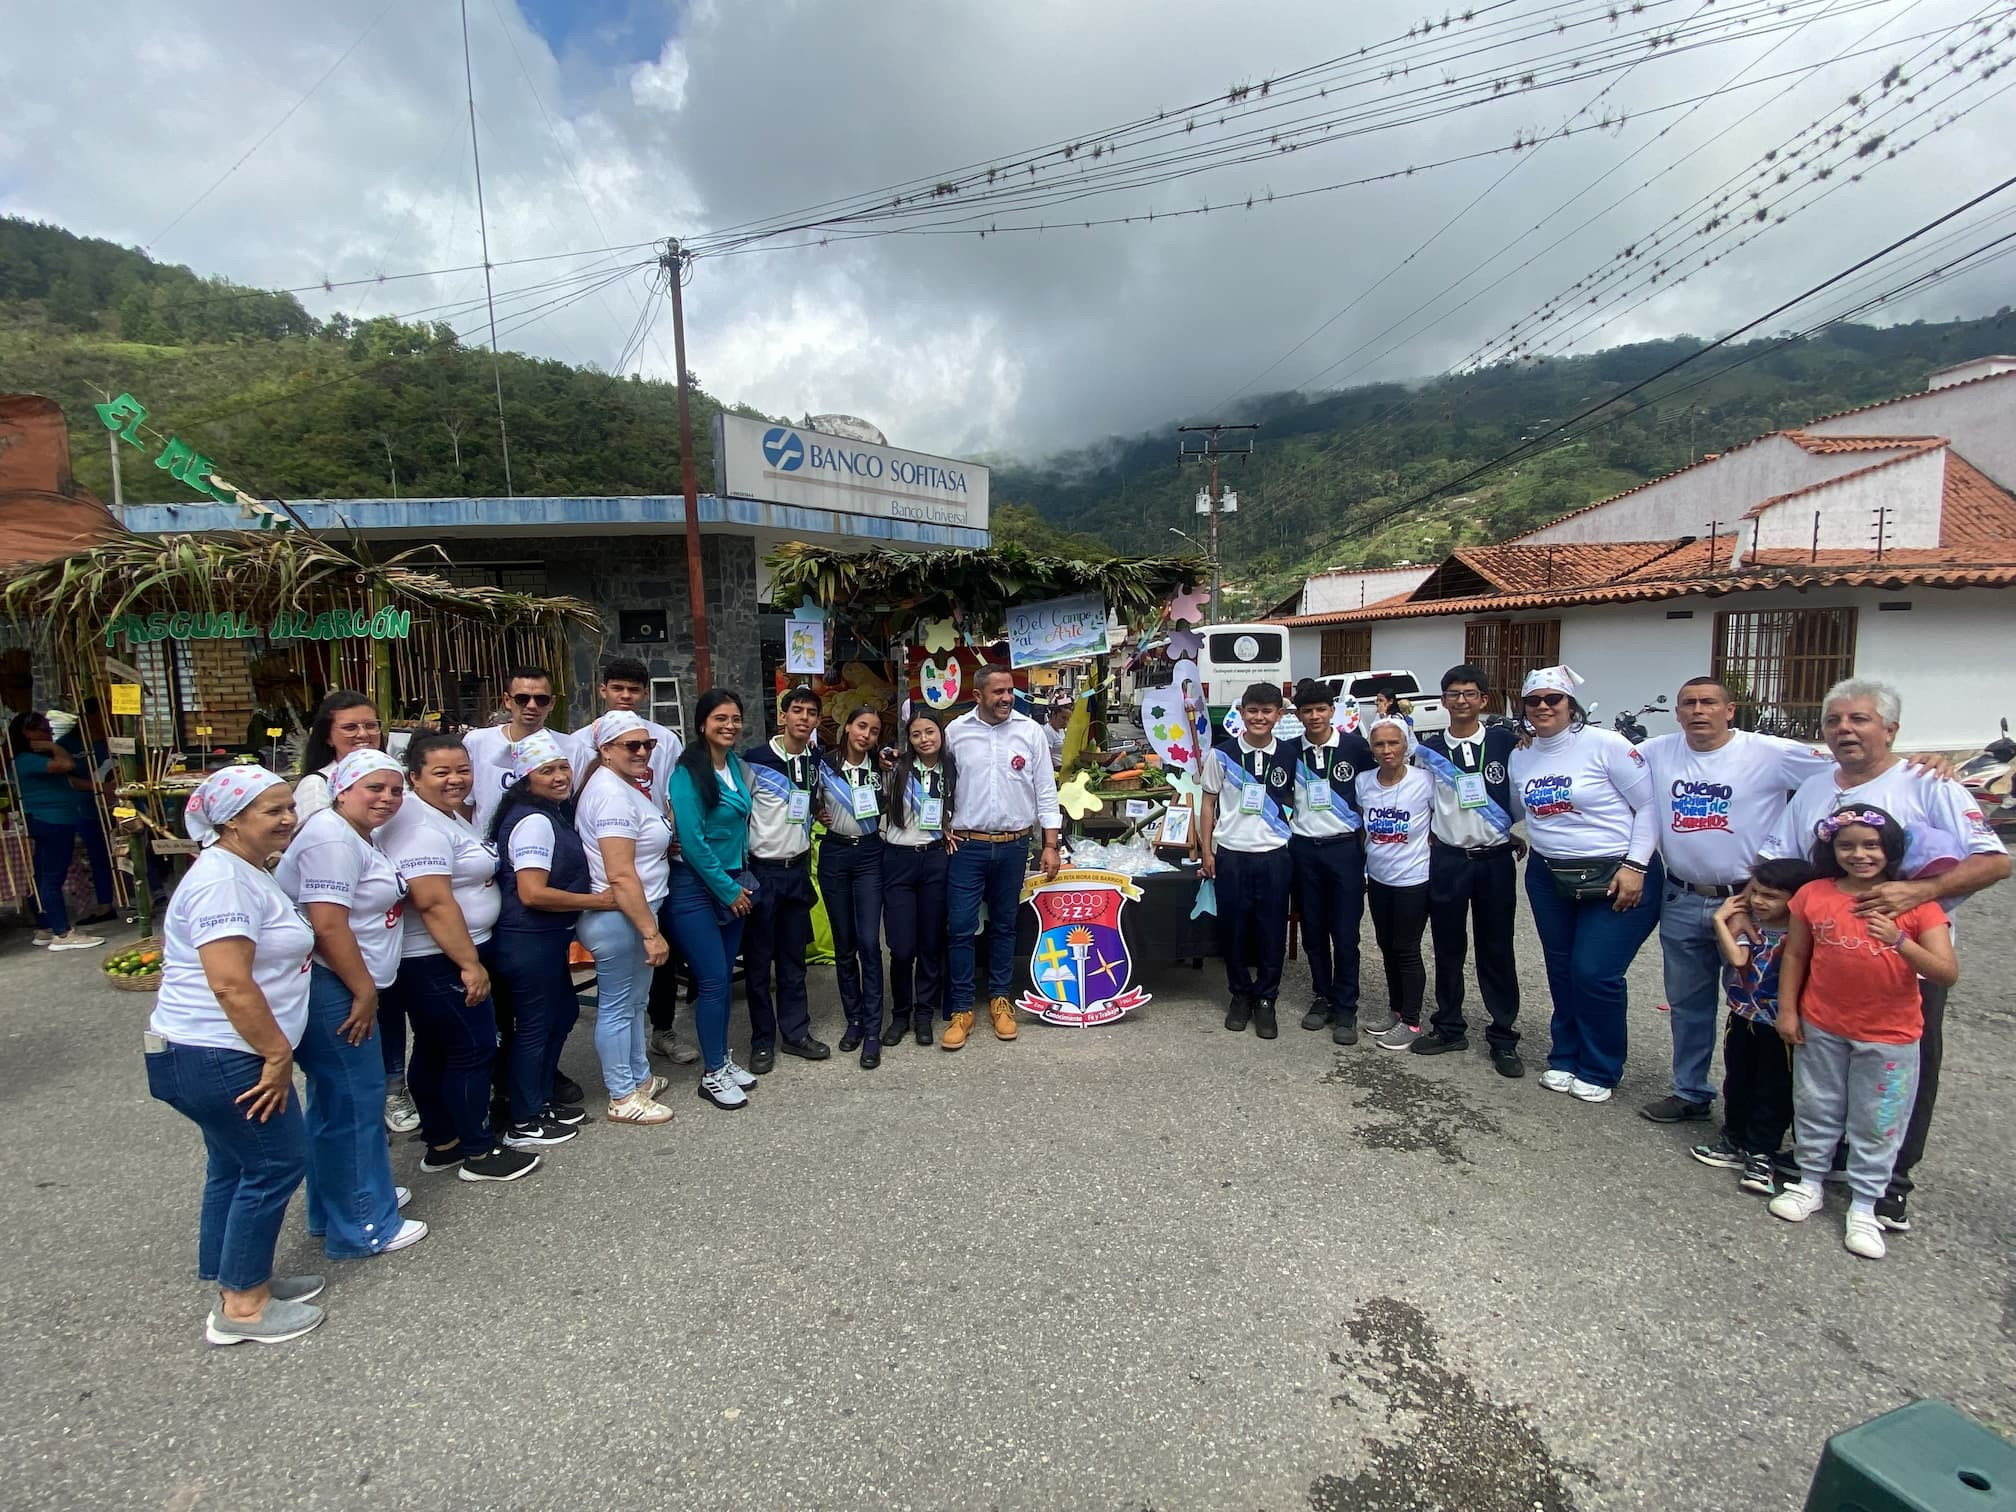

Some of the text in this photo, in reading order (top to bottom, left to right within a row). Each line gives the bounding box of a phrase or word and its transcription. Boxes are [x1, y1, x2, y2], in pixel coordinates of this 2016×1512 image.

[810, 445, 967, 493] BANCO SOFITASA
[891, 501, 968, 525] Banco Universal
[104, 605, 410, 647] PASCUAL ALARCÓN
[1015, 609, 1092, 635] Del Campo
[1020, 624, 1084, 647] al Arte
[1709, 799, 1729, 814] de
